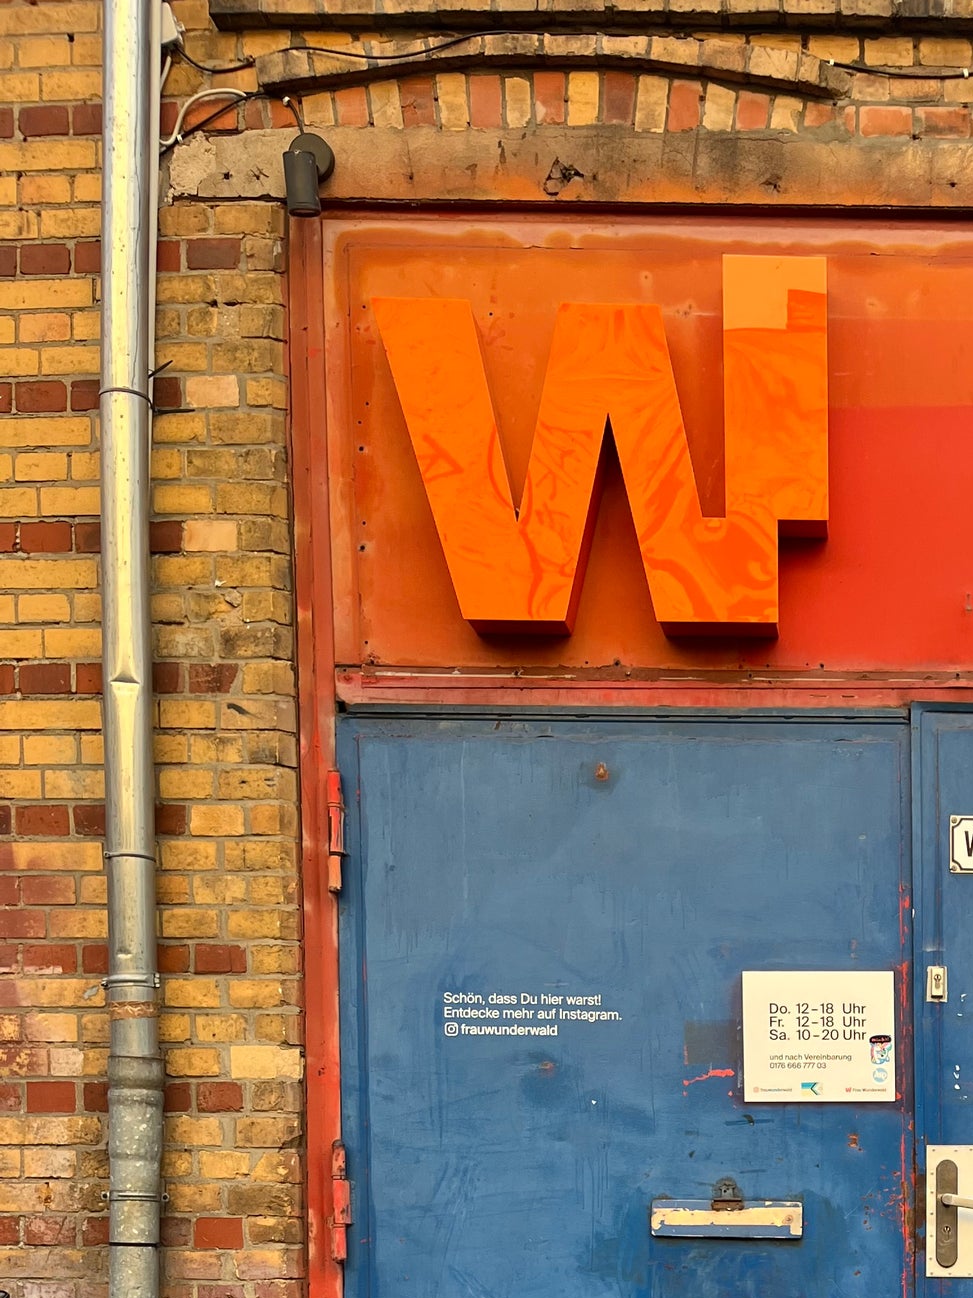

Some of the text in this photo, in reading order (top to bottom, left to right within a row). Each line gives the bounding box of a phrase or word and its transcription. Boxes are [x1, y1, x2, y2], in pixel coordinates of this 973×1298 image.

[443, 992, 602, 1006] Schön, dass Du hier warst!
[443, 1007, 623, 1022] Entdecke mehr auf Instagram.
[769, 1003, 791, 1014] Do.
[842, 1003, 867, 1014] Uhr
[769, 1016, 785, 1027] Fr.
[842, 1016, 867, 1027] Uhr
[460, 1024, 558, 1036] frauwunderwald
[769, 1029, 790, 1041] Sa.
[843, 1029, 867, 1041] Uhr
[804, 1054, 852, 1062] Vereinbarung
